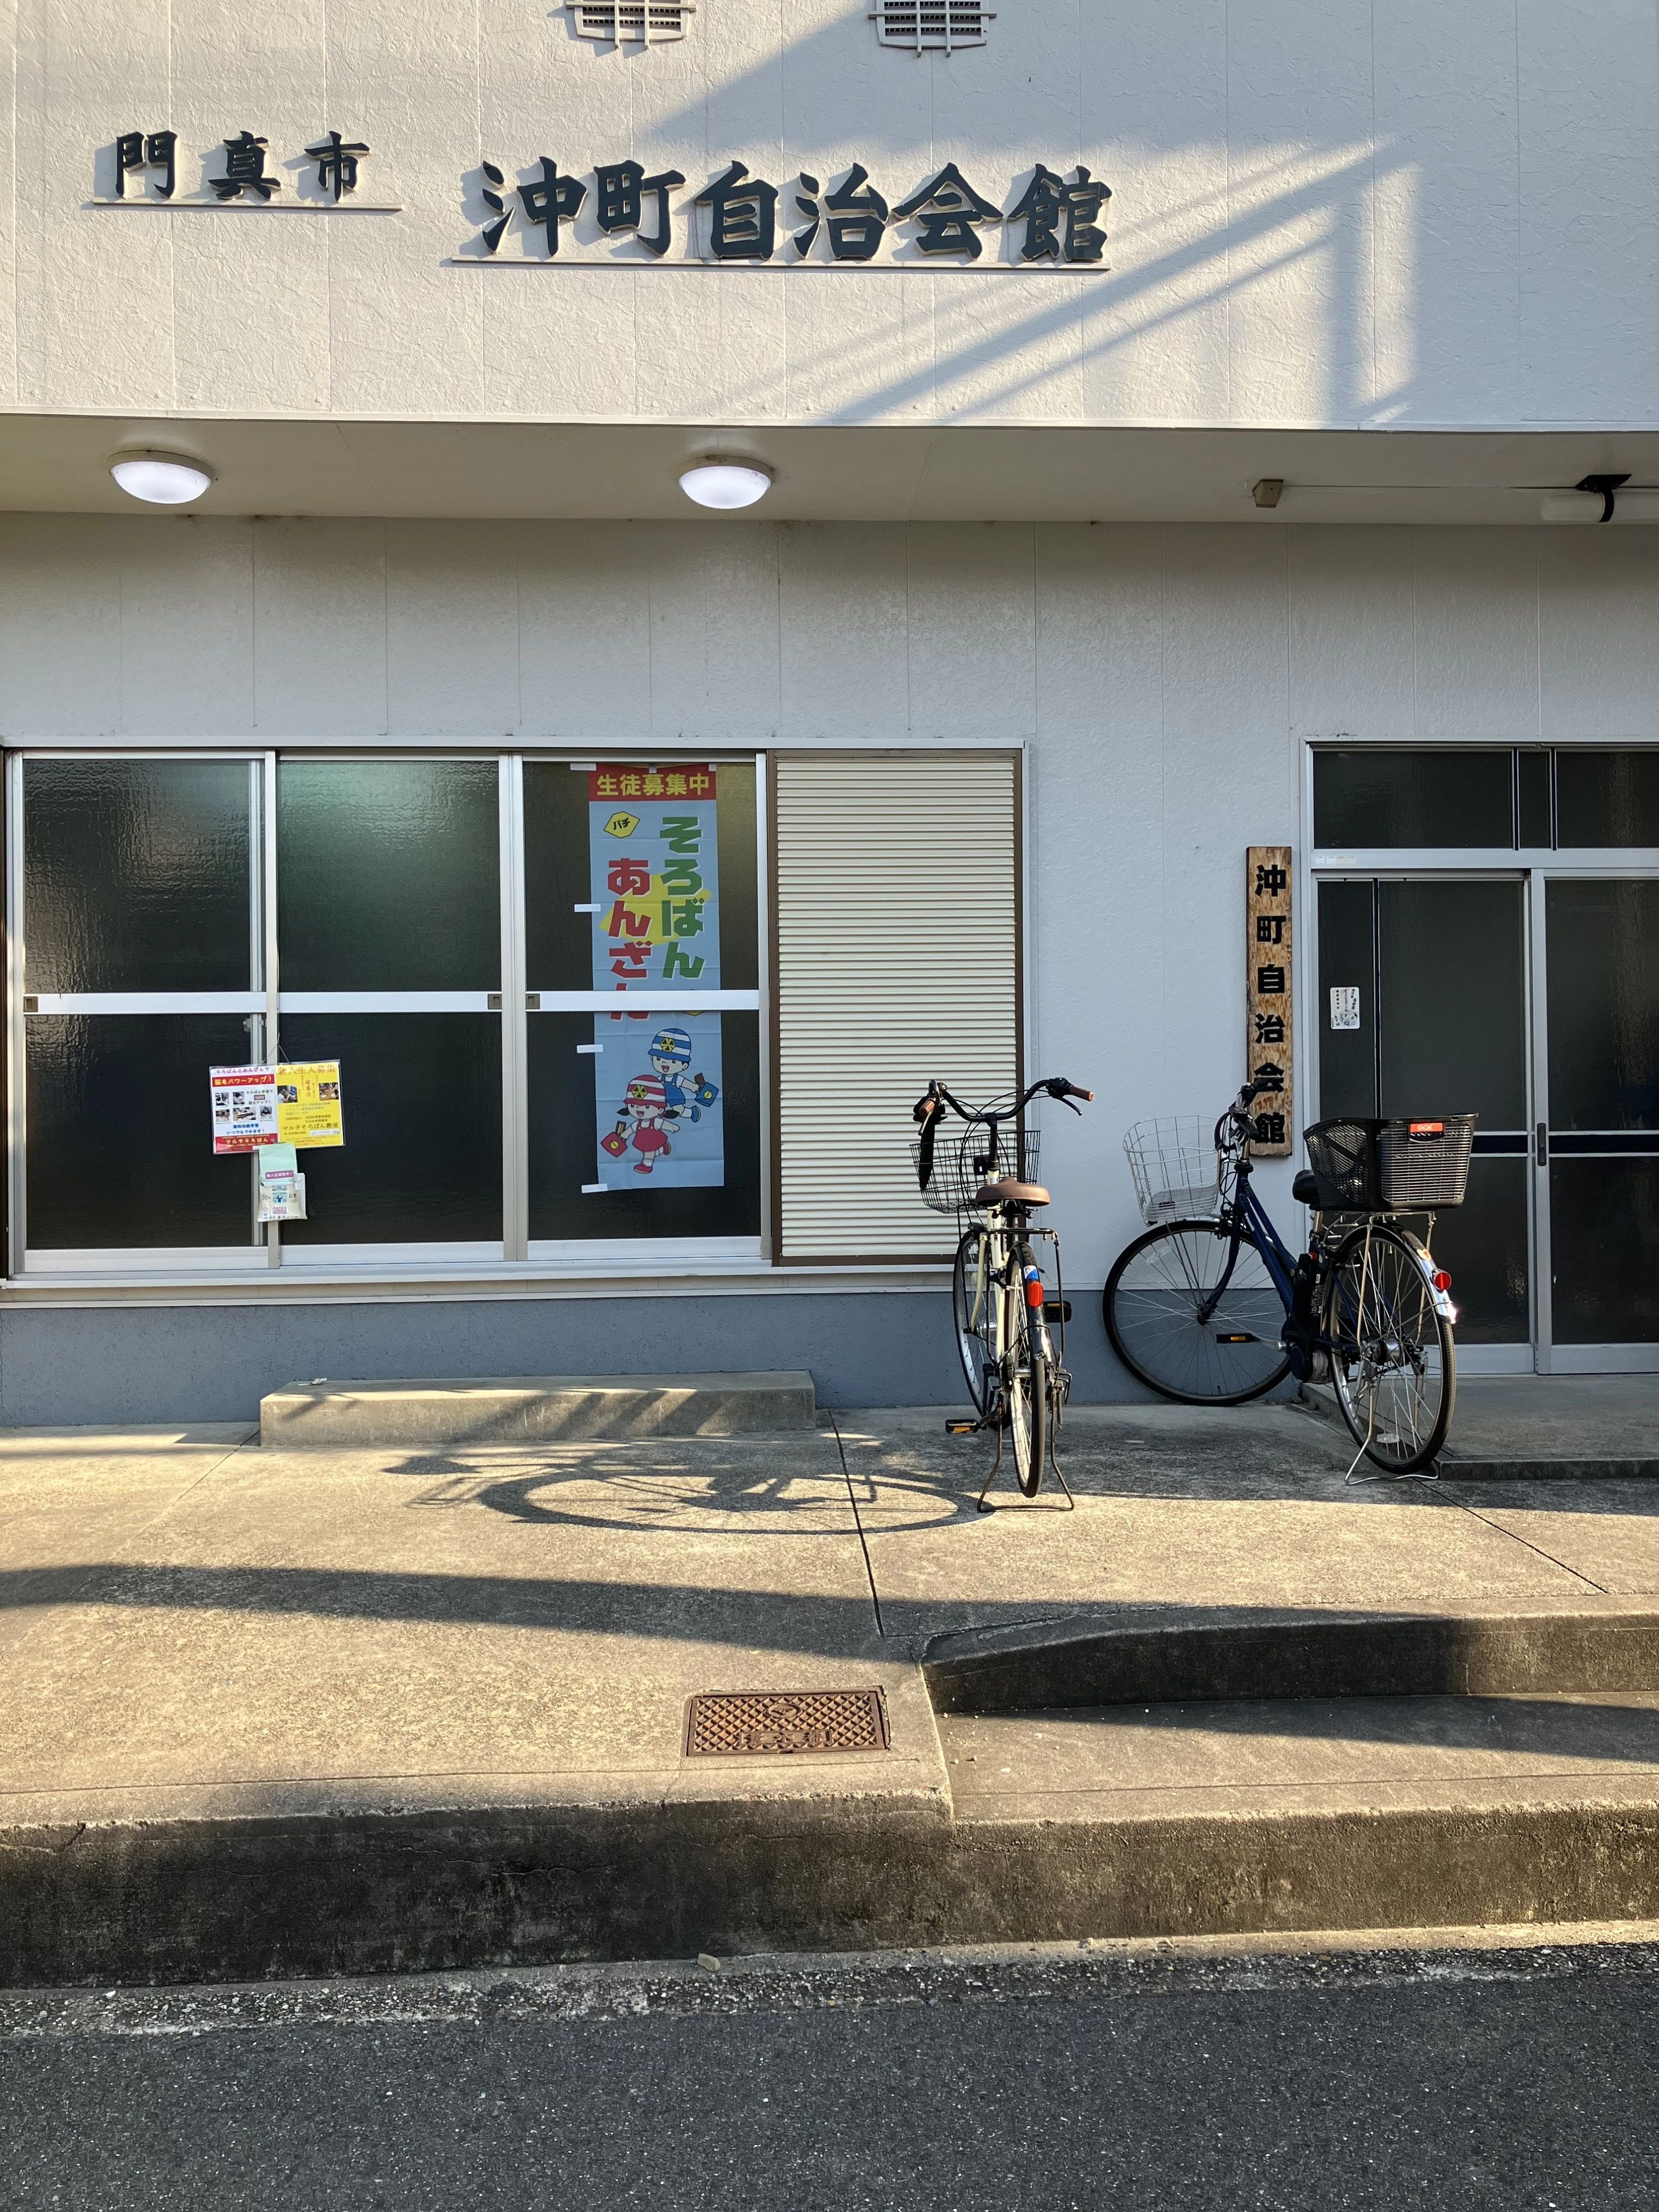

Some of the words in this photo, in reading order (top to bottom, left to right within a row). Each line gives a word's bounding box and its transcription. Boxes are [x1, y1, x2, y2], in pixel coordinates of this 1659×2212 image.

[116, 131, 370, 202] 門真市
[482, 156, 1113, 260] 沖町自治会館
[597, 773, 709, 796] 生徒募集中
[660, 816, 705, 979] そろばん
[1254, 864, 1287, 1144] 沖町自治会館
[1417, 1123, 1434, 1131] OGK
